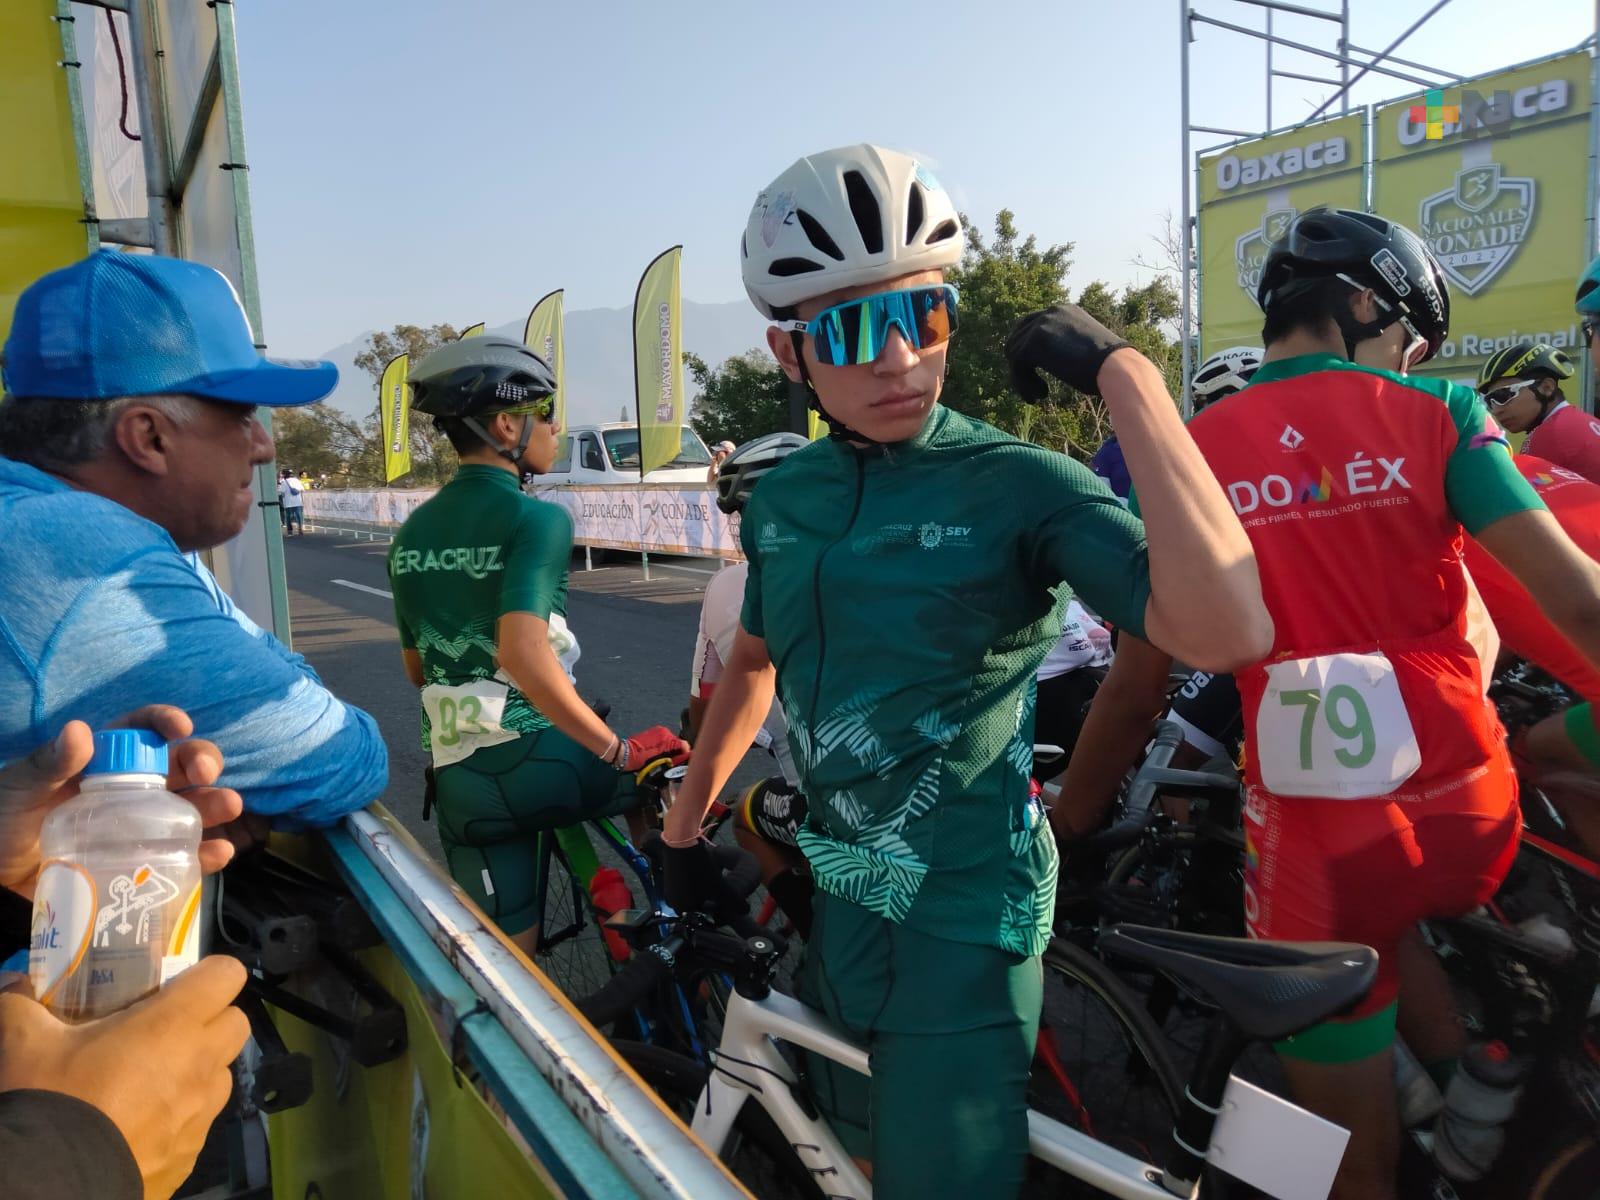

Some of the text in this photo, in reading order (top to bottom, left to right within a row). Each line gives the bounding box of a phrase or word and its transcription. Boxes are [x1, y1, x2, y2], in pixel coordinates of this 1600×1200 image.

[1217, 137, 1346, 190] Oaxaca
[1422, 207, 1529, 237] NACIONALES
[1448, 250, 1497, 266] 2022
[1420, 276, 1444, 322] RUDY
[659, 303, 673, 400] MAYORDOMO
[583, 499, 709, 521] EDUCACIÓN CONADE
[946, 527, 972, 536] SEV
[389, 545, 504, 579] VERACRUZ
[1279, 684, 1376, 770] 79
